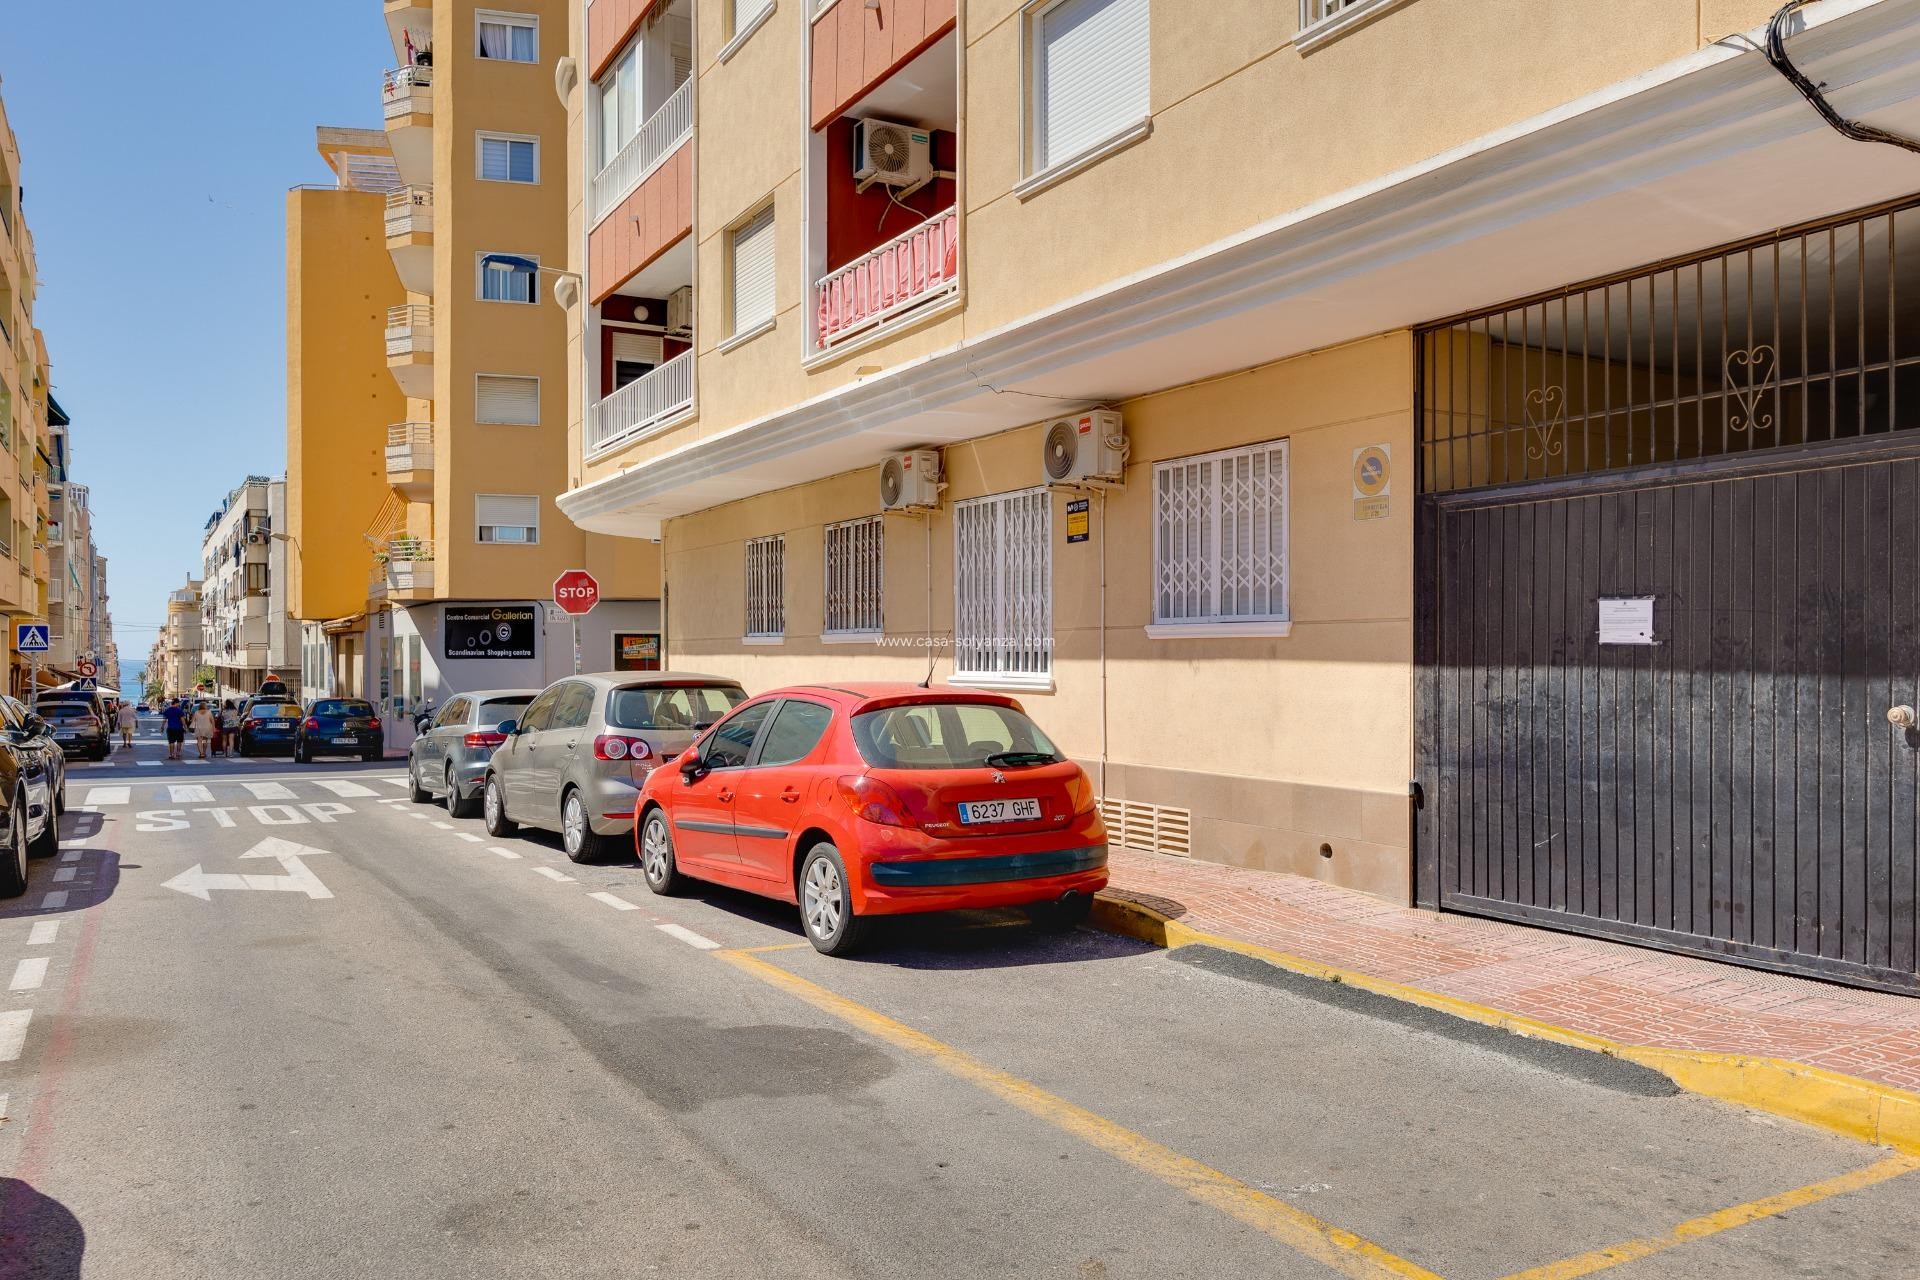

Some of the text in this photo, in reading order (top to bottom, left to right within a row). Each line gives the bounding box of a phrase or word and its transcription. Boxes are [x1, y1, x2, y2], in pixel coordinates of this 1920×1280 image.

[559, 587, 595, 598] STOP
[491, 608, 533, 620] Gallerian
[487, 649, 512, 657] Shopping
[971, 801, 1036, 819] 6237 GHF
[135, 802, 357, 832] STOP
